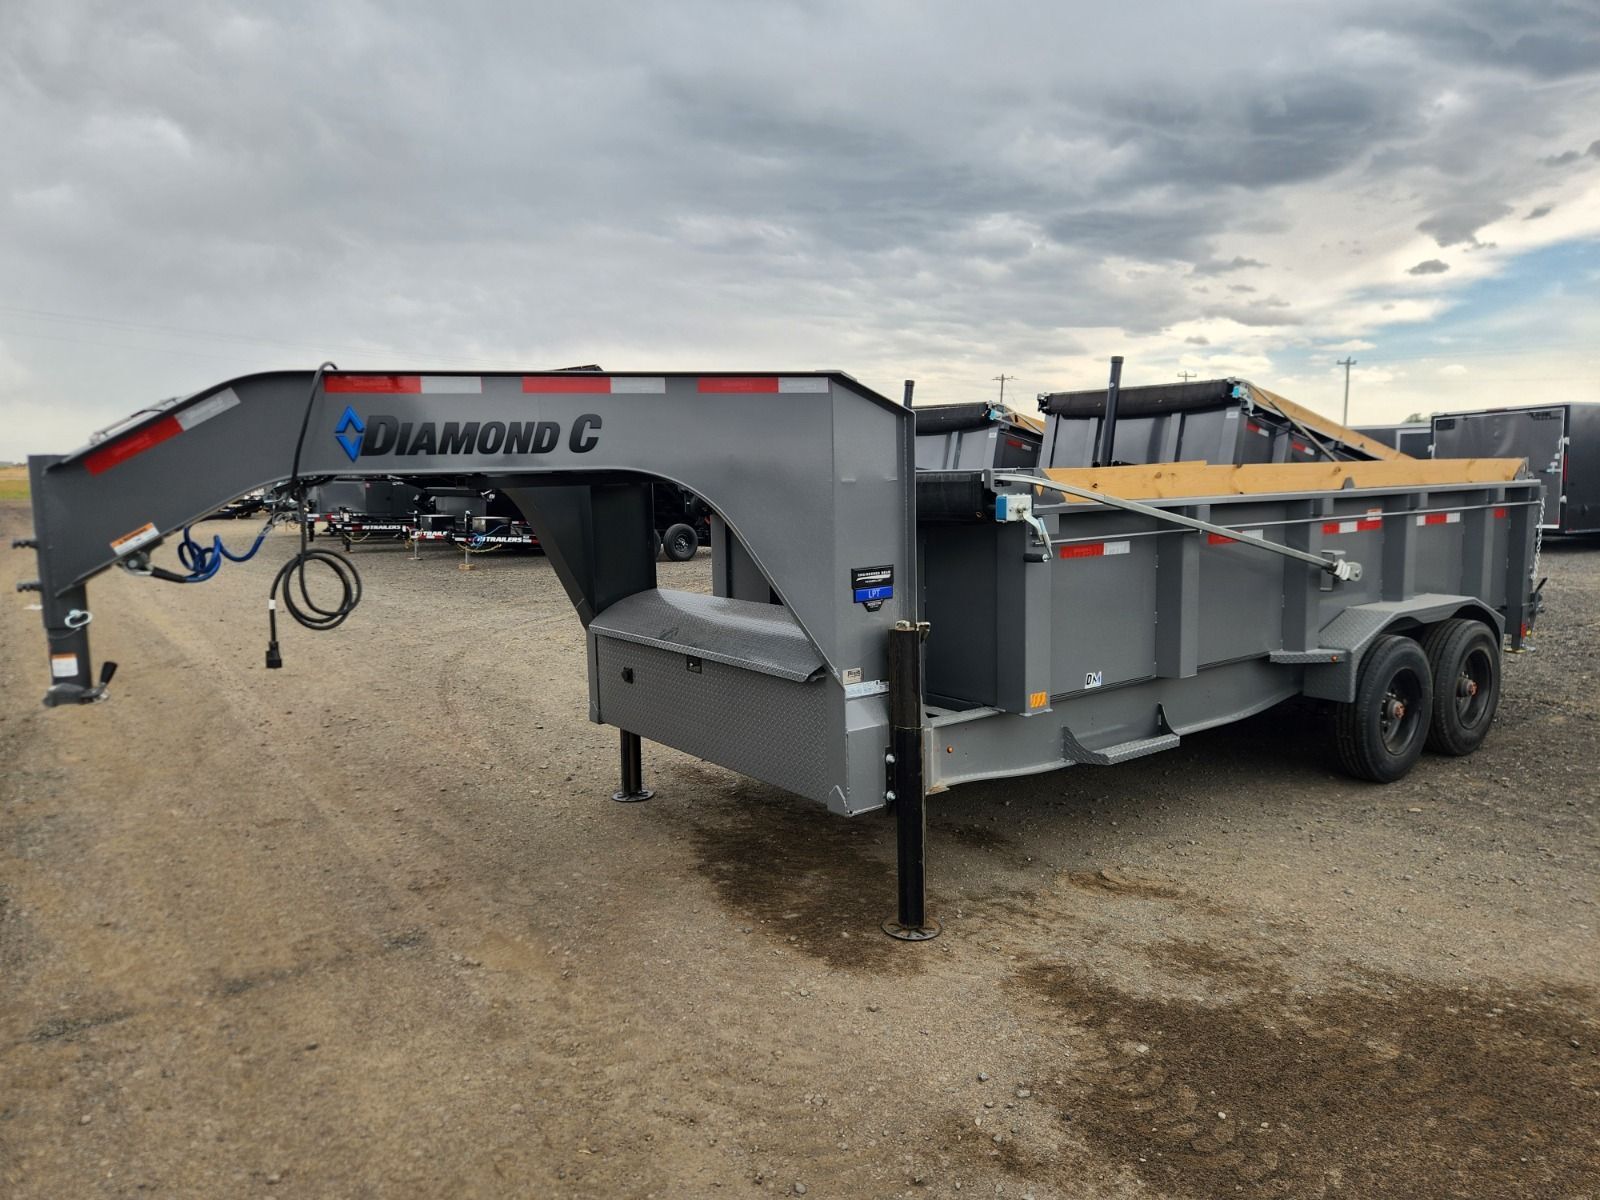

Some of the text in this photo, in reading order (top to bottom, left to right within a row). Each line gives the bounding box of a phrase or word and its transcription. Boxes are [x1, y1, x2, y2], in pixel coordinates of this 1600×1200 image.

[360, 413, 603, 457] DIAMOND C
[868, 589, 880, 599] LPT
